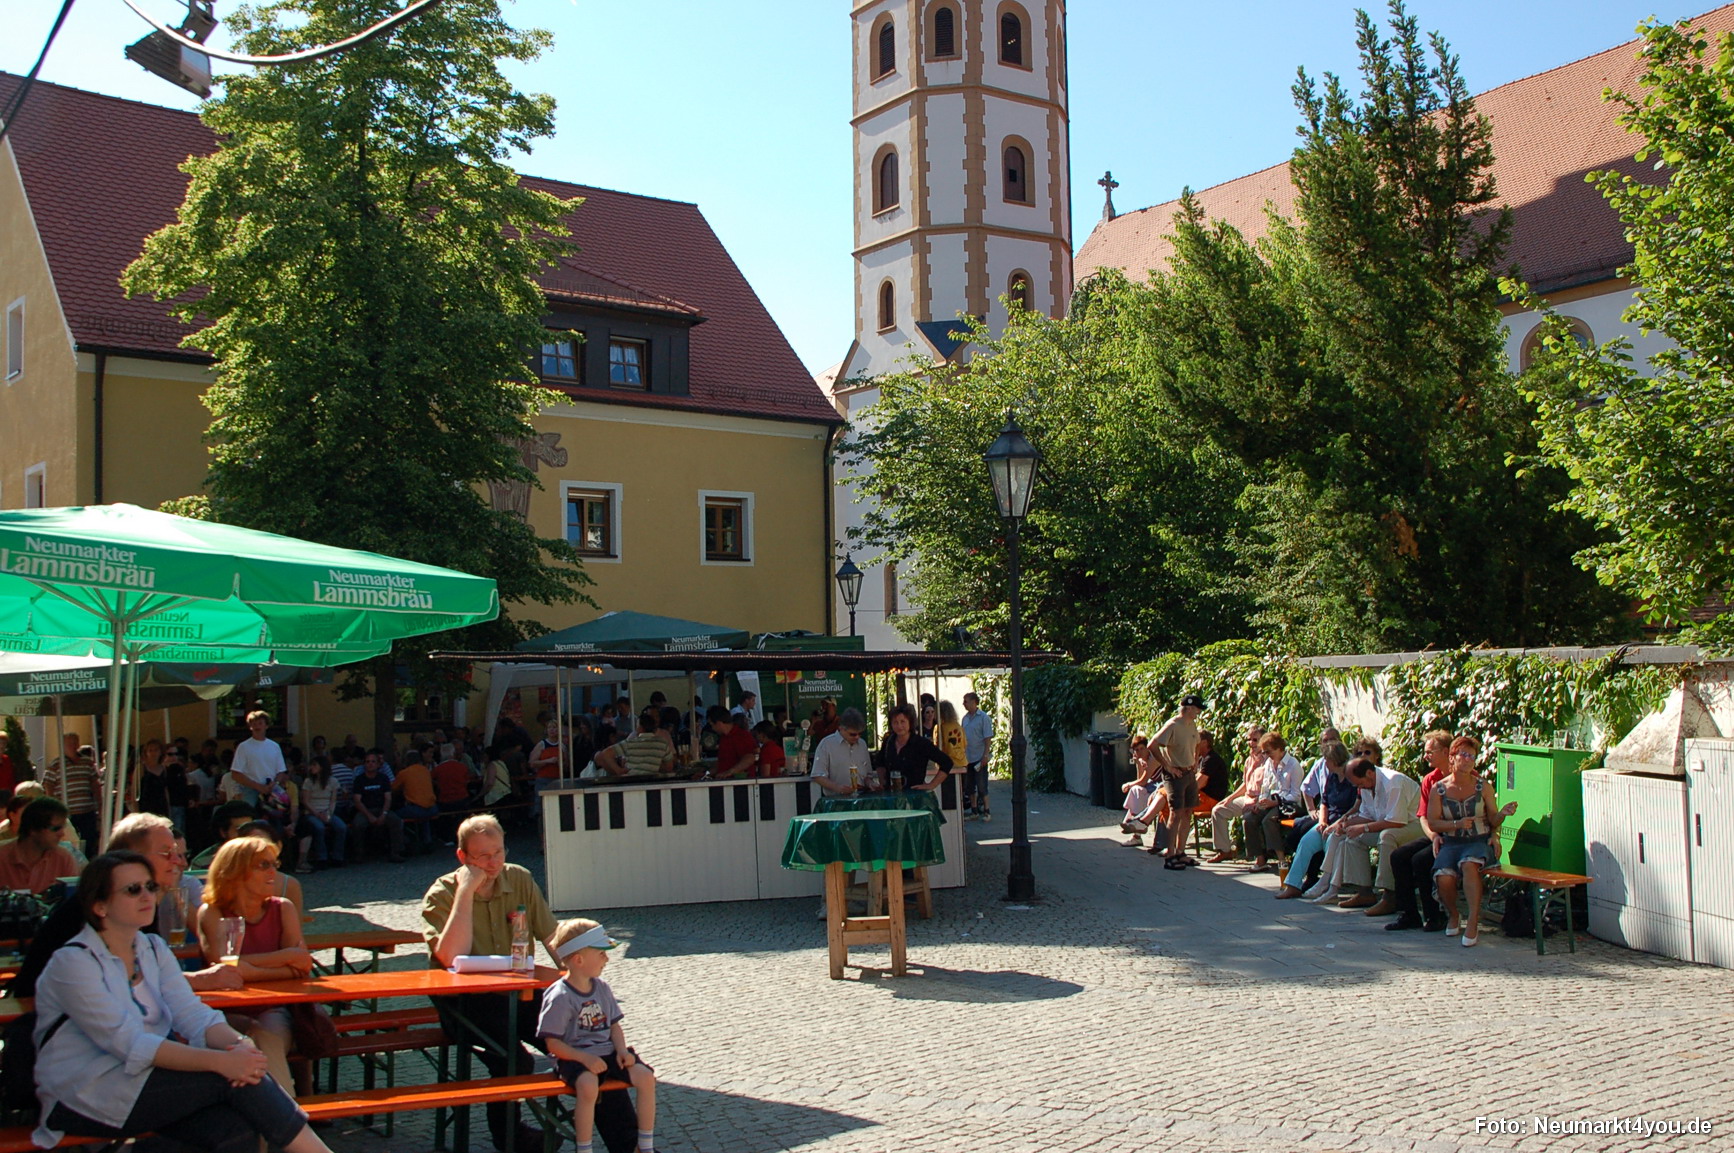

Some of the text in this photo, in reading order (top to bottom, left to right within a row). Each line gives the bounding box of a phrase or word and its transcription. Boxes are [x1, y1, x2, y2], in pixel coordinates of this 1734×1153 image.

[25, 536, 137, 563] Neumarkter
[0, 549, 156, 588] Lammsbräu
[329, 569, 415, 588] Neumarkter
[313, 581, 433, 609] Lammsbräu
[664, 640, 719, 652] Lammsbräu
[671, 634, 711, 643] Neumarkter
[555, 642, 595, 651] Neumarkter
[30, 670, 95, 681] Neumarkter
[18, 679, 107, 694] Lammsbräu
